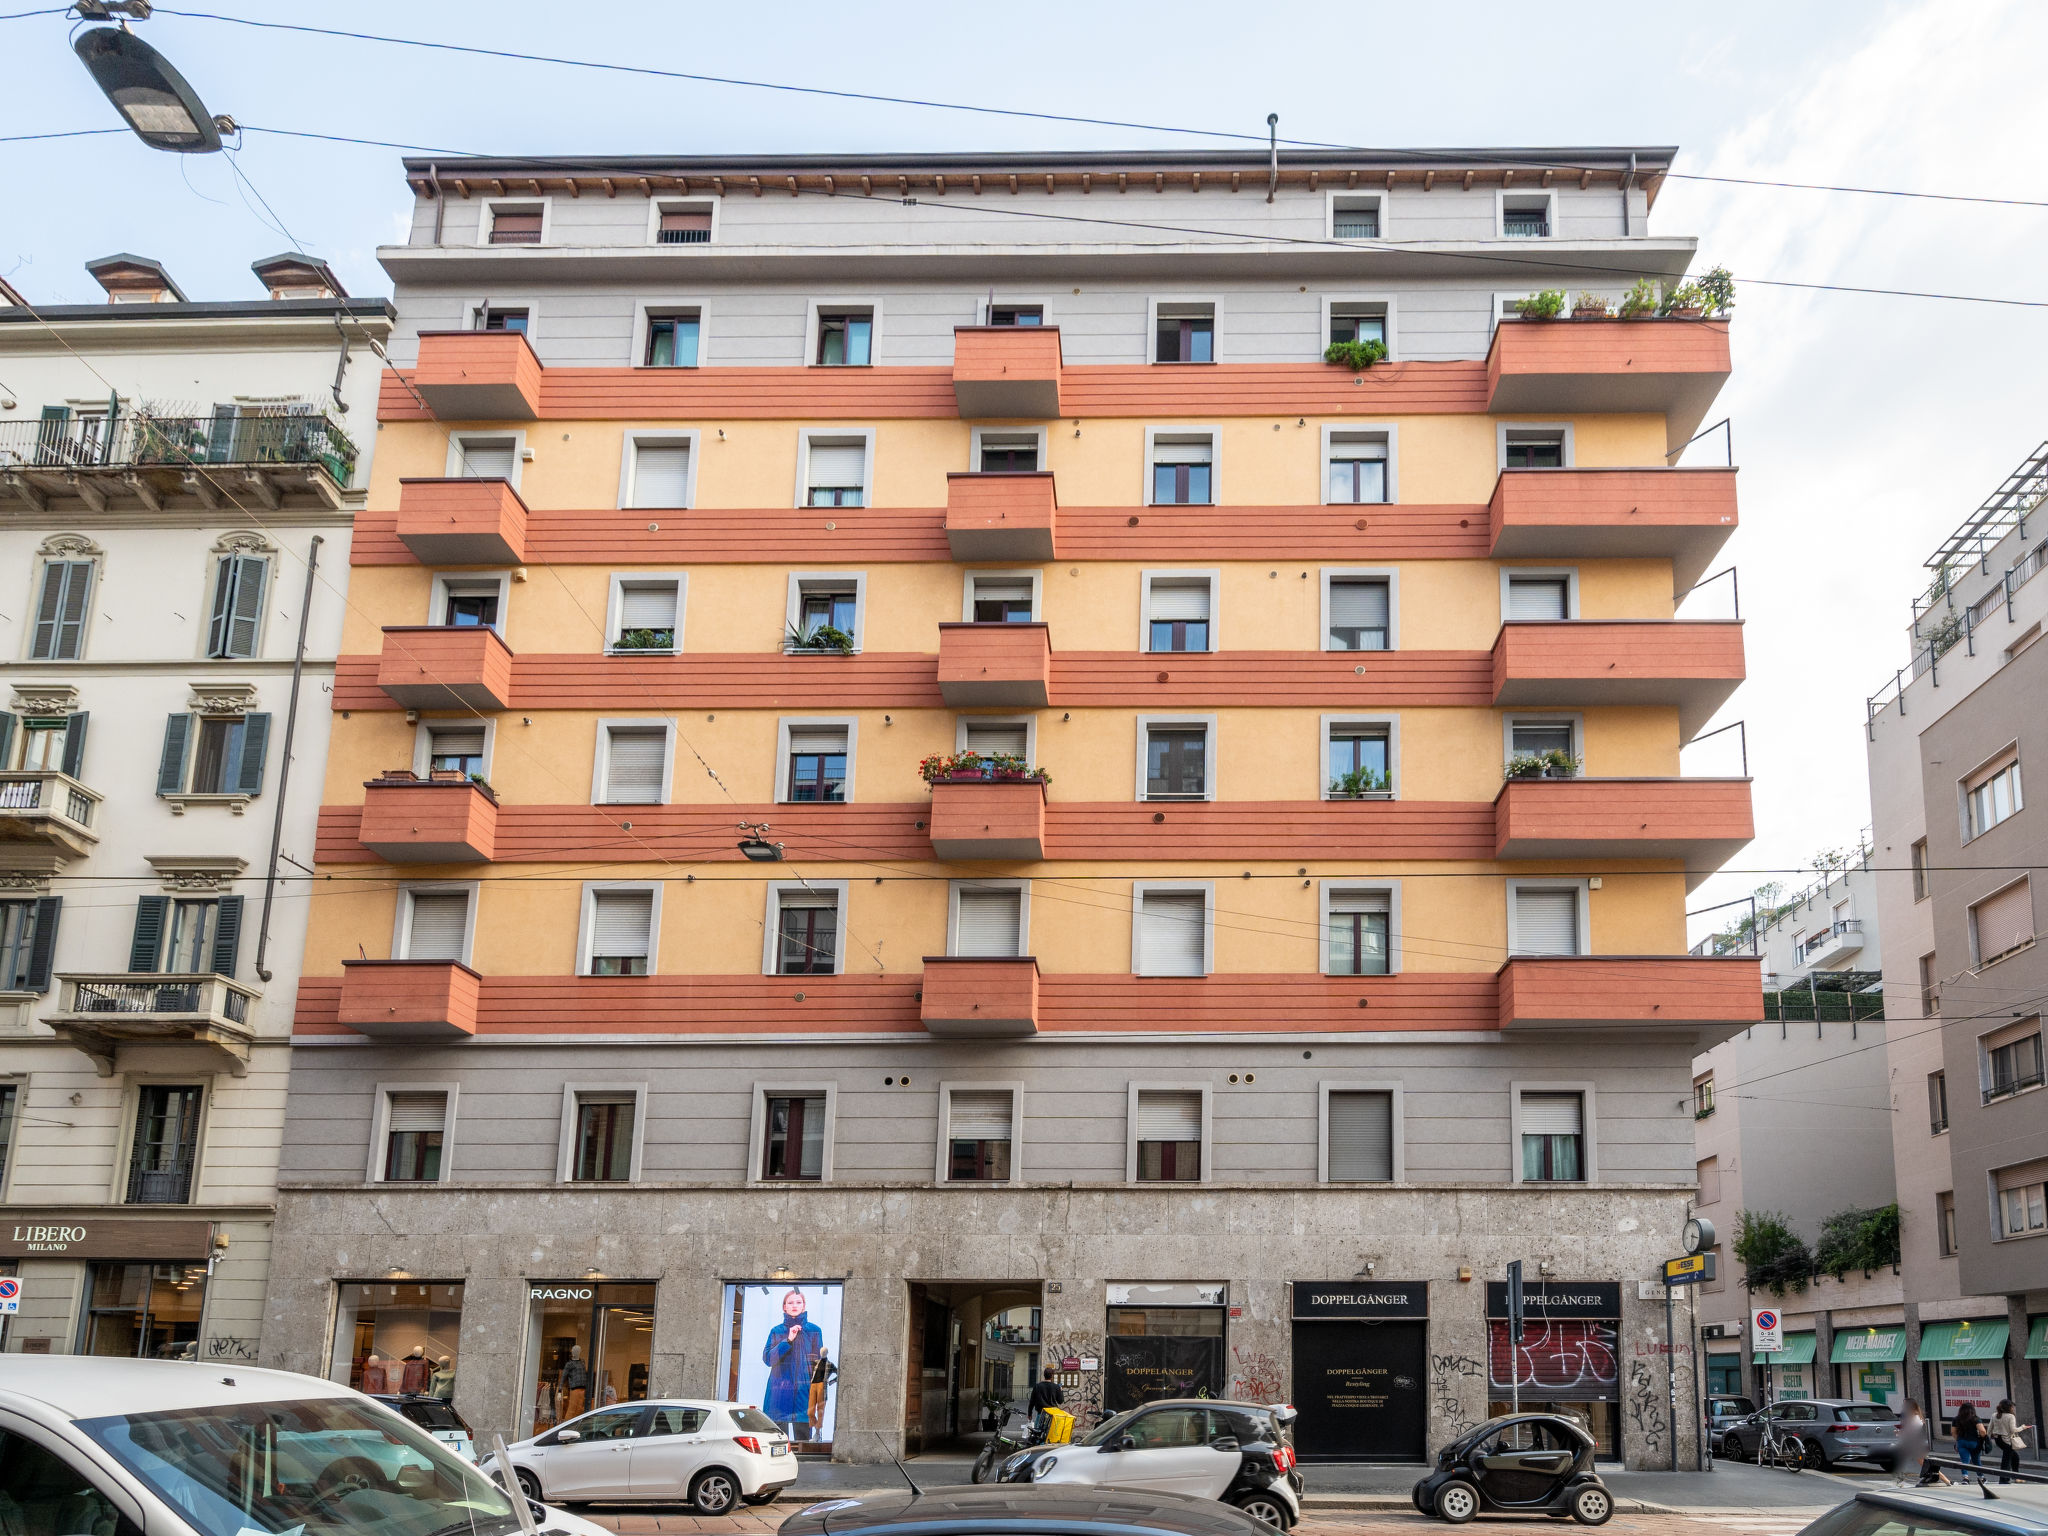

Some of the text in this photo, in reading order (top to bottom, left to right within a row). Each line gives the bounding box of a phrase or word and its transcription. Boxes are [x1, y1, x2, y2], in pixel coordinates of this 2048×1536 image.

[12, 1226, 87, 1242] LIBERO
[27, 1243, 67, 1251] MILANO
[531, 1288, 593, 1300] RAGNO
[1311, 1294, 1409, 1305] DOPPELGÄNGER
[1505, 1295, 1603, 1306] PPELGÄNGER
[1845, 1333, 1898, 1350] MEDI-MARKET
[1783, 1375, 1803, 1388] SCELTA
